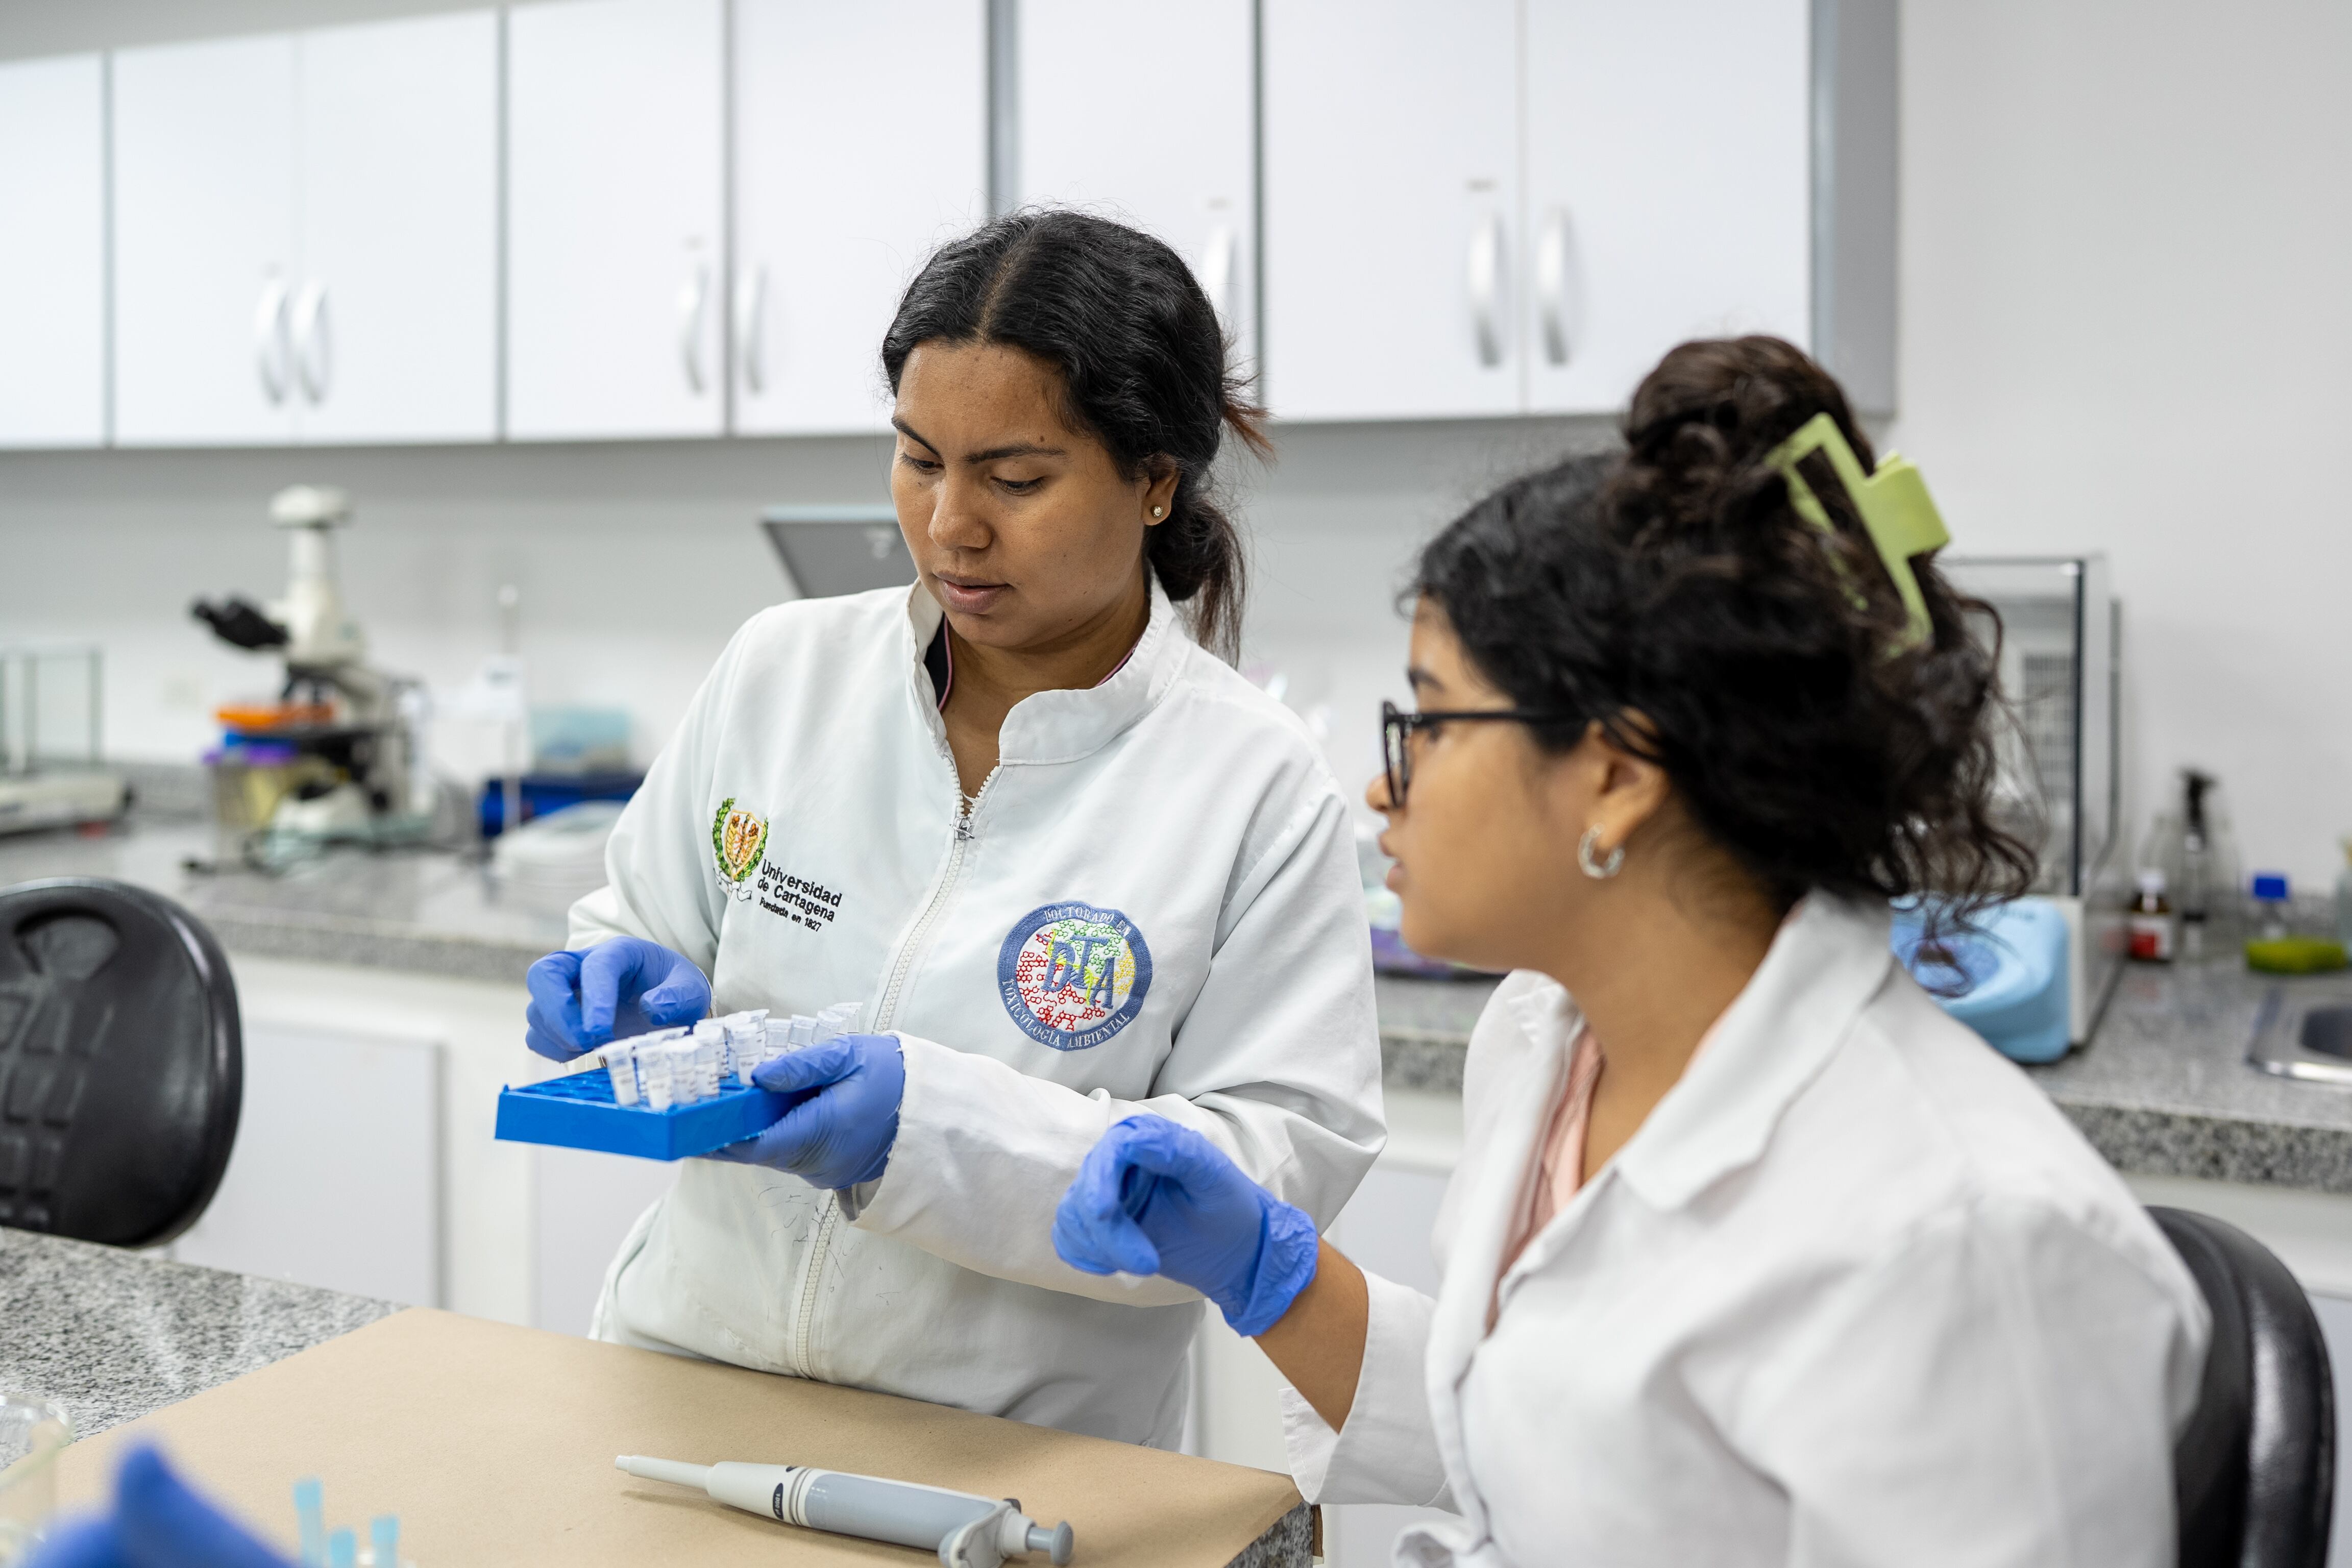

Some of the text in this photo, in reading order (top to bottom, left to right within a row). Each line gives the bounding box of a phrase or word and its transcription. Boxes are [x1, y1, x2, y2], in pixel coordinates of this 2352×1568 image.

[757, 877, 835, 922] de Cartagena
[762, 859, 842, 907] Universidad
[760, 897, 821, 932] Fundada en 1827
[1044, 906, 1114, 923] DOCTORADO
[1067, 1013, 1130, 1048] AMBIENTAL
